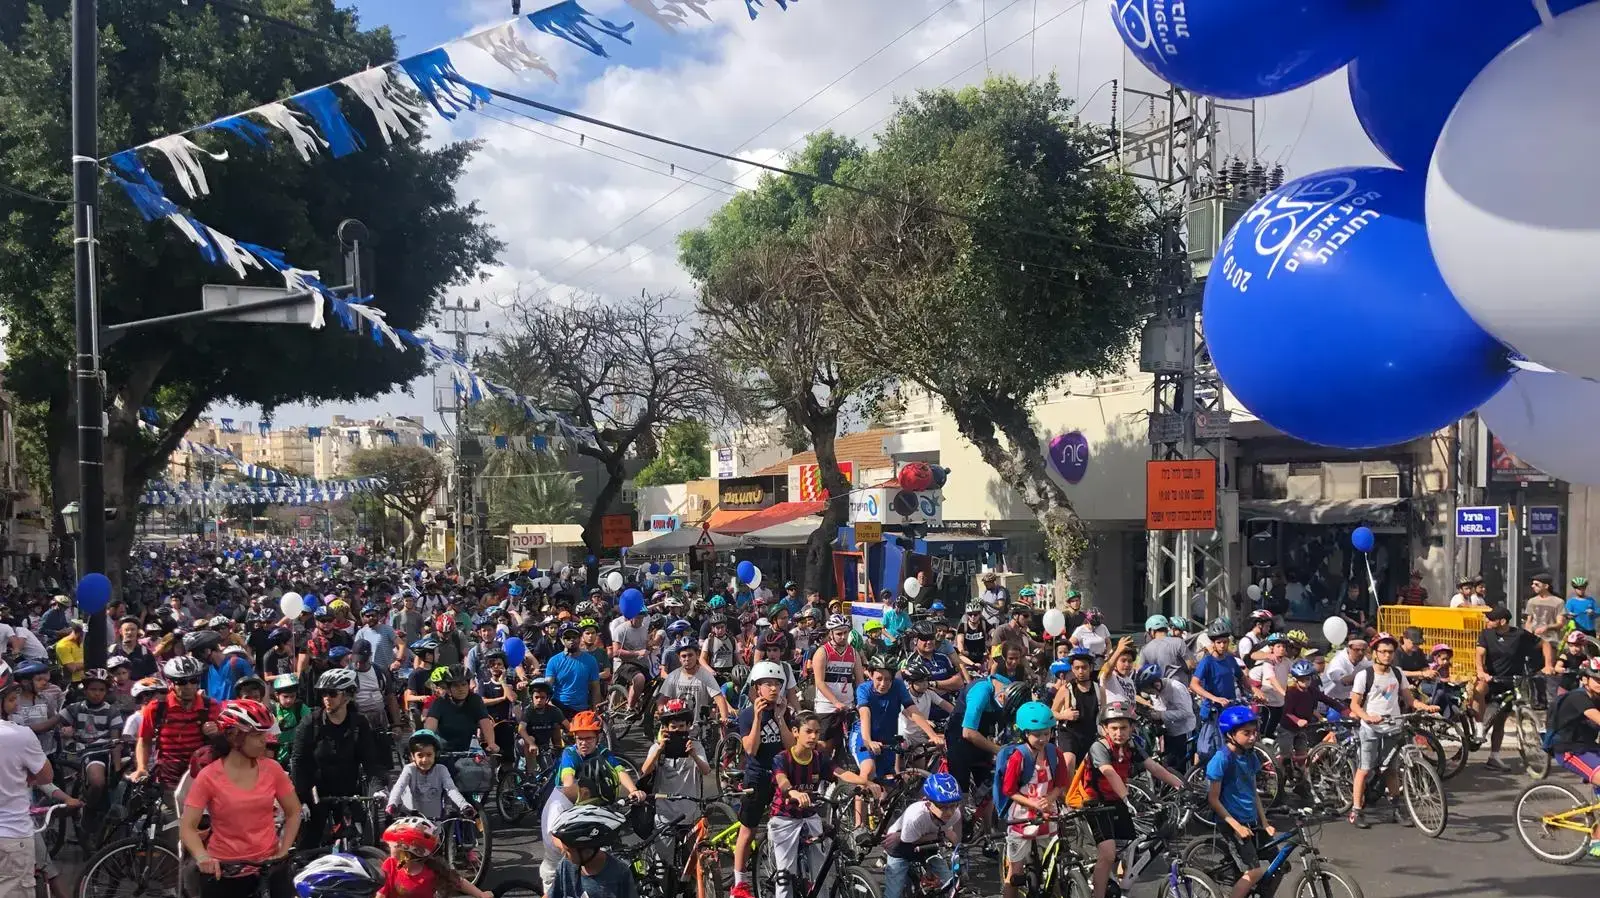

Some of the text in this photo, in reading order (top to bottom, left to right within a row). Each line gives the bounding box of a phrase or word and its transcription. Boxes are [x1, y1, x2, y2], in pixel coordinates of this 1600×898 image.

[1153, 0, 1178, 55] ופניים
[1339, 191, 1382, 215] מסע
[1285, 213, 1340, 272] אופניים
[1316, 209, 1381, 264] רחובות
[1223, 255, 1252, 292] 2019
[1463, 512, 1484, 521] הרצל
[1460, 524, 1485, 532] HERZL
[513, 536, 544, 546] כניסה
[840, 676, 848, 694] 2
[761, 733, 781, 744] dida
